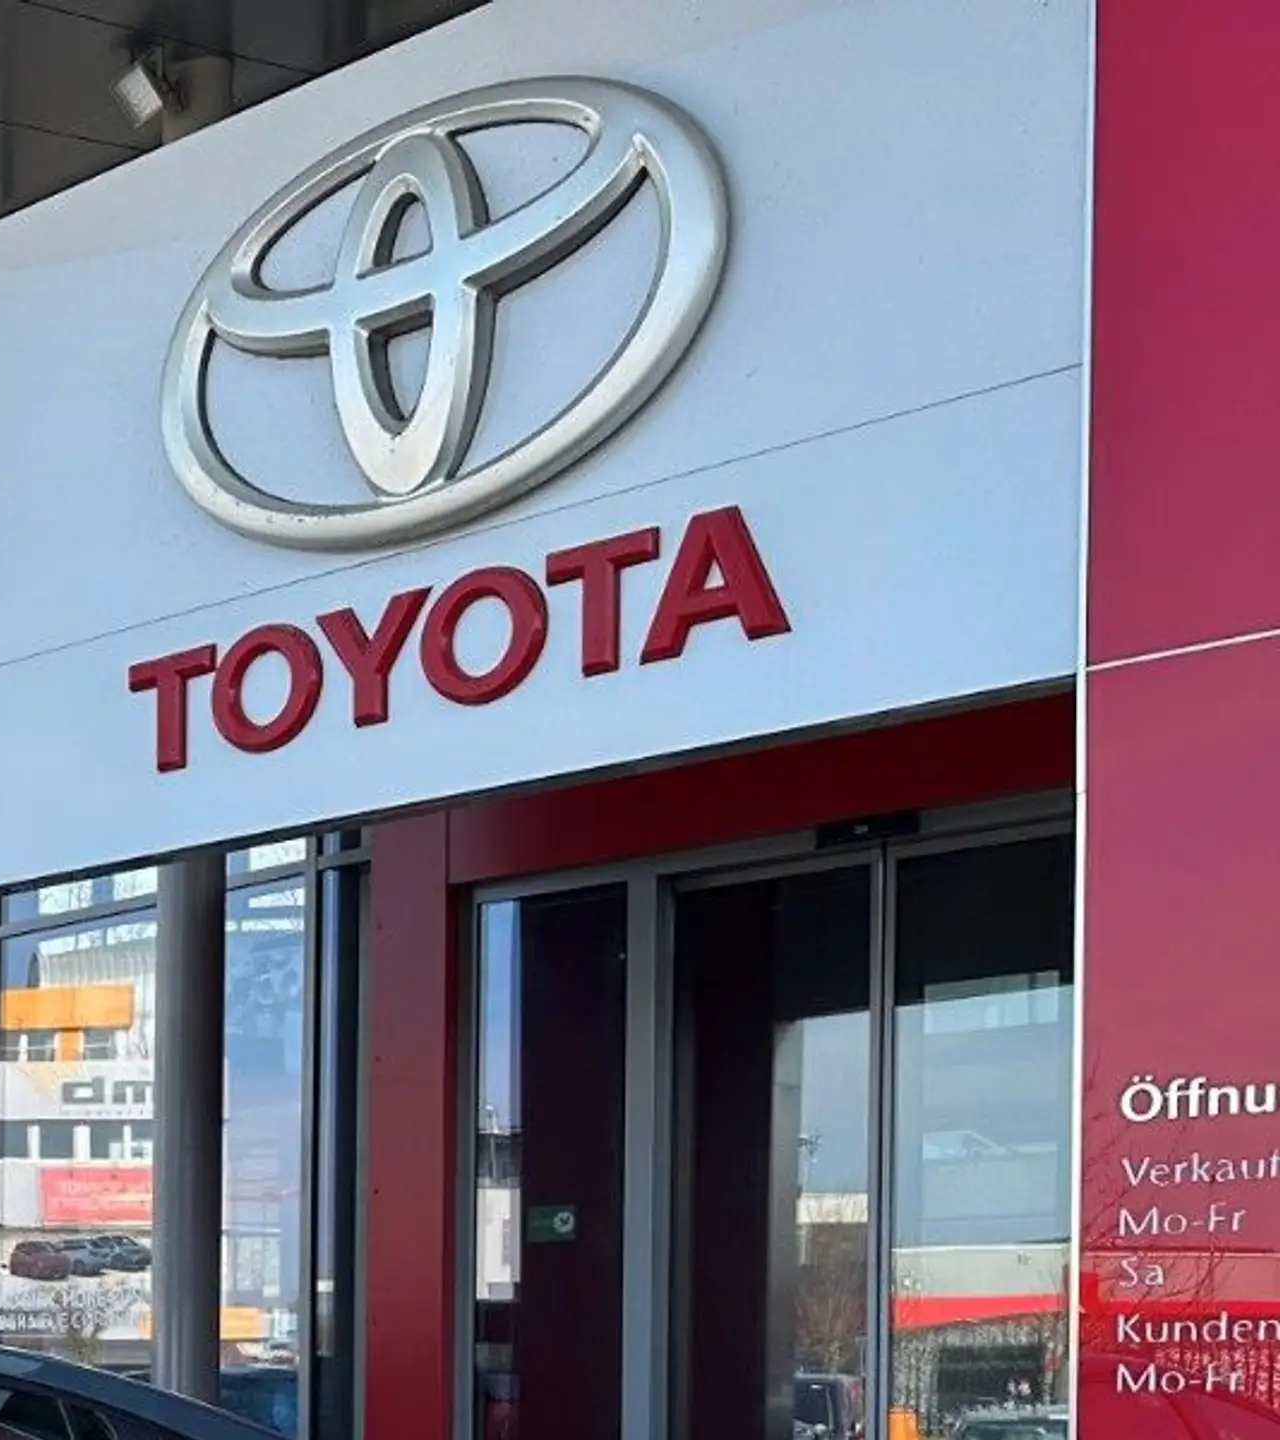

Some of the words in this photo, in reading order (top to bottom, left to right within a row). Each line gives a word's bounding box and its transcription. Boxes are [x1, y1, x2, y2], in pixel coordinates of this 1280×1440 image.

[129, 505, 791, 772] TOYOTA
[1121, 1075, 1276, 1122] Öffnu
[1118, 1203, 1246, 1237] Mo-Fr
[1119, 1256, 1166, 1287] Sa
[1116, 1311, 1280, 1343] Kunden
[1115, 1363, 1243, 1394] Mo-Fr
